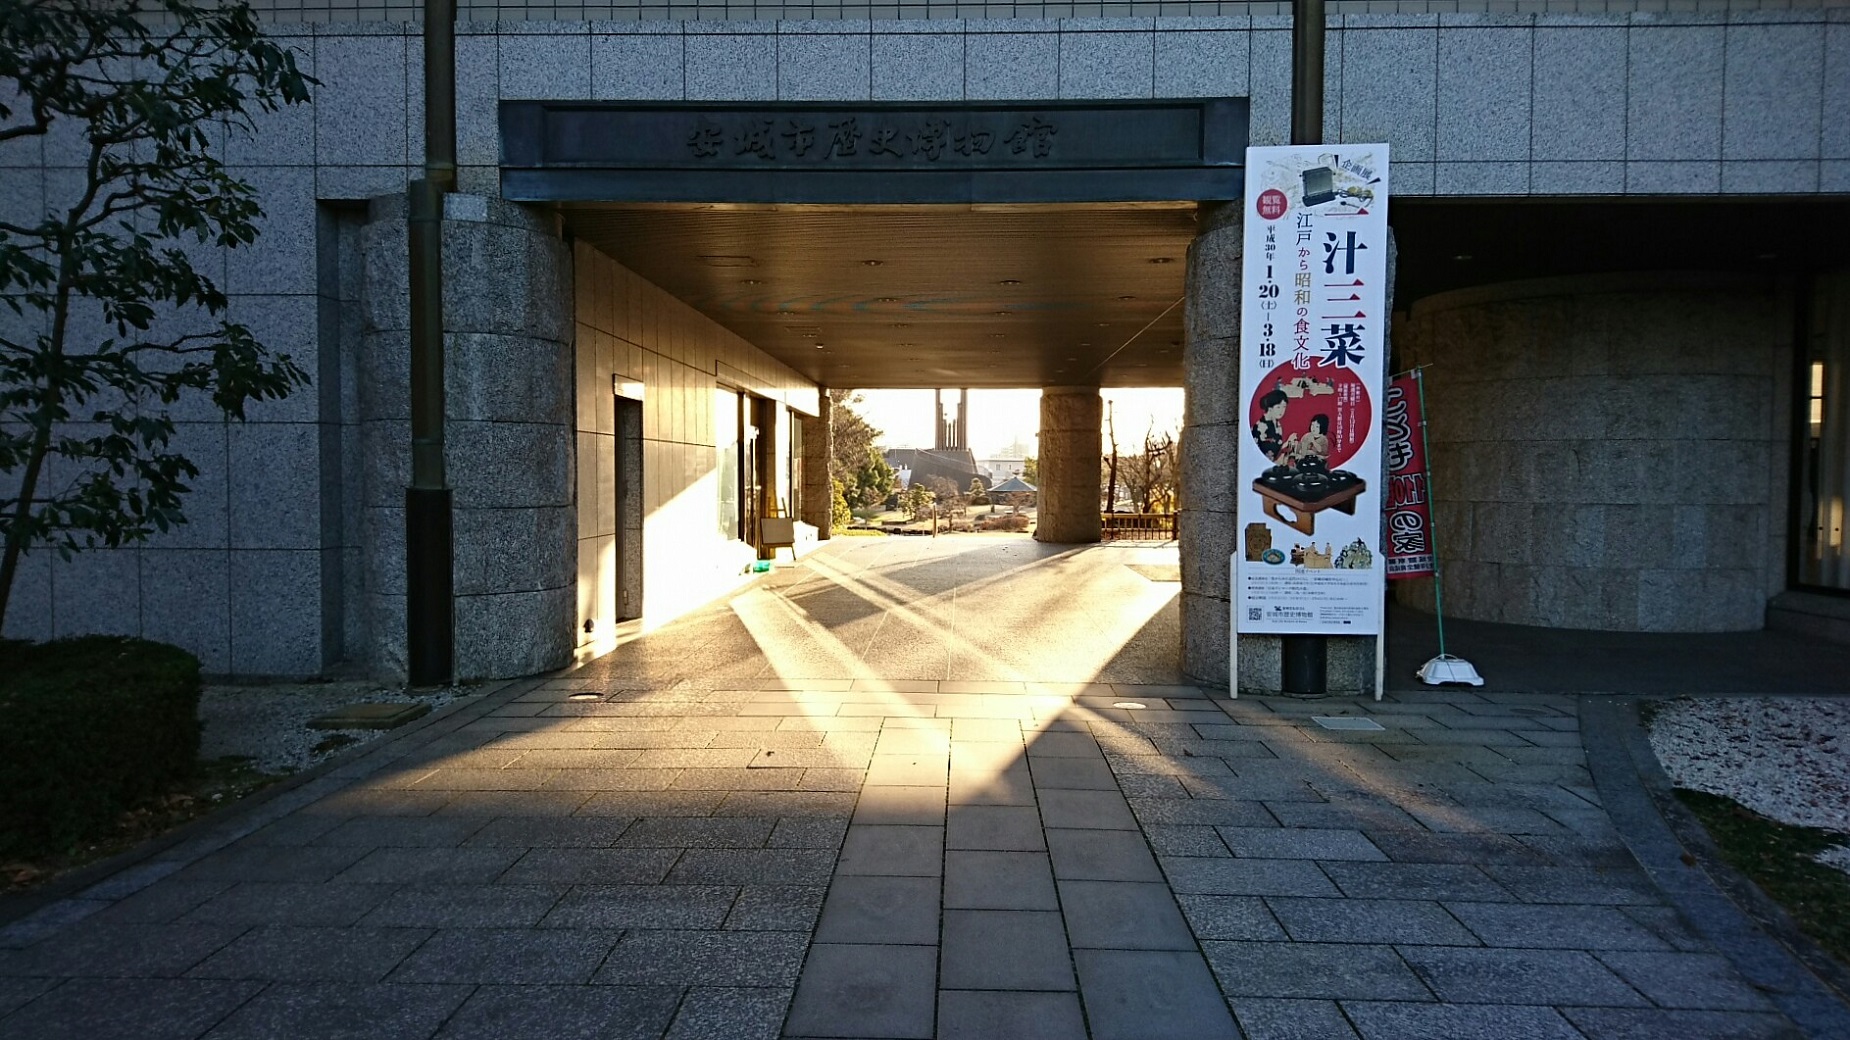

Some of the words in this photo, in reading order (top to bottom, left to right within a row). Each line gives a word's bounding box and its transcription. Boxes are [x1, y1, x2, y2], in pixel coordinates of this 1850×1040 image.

[1341, 158, 1373, 180] 企画展
[1262, 195, 1281, 205] 観覧
[1262, 205, 1281, 215] 無料
[1291, 212, 1313, 370] 江戸から昭和の食文化
[1319, 207, 1370, 367] 一汁三菜
